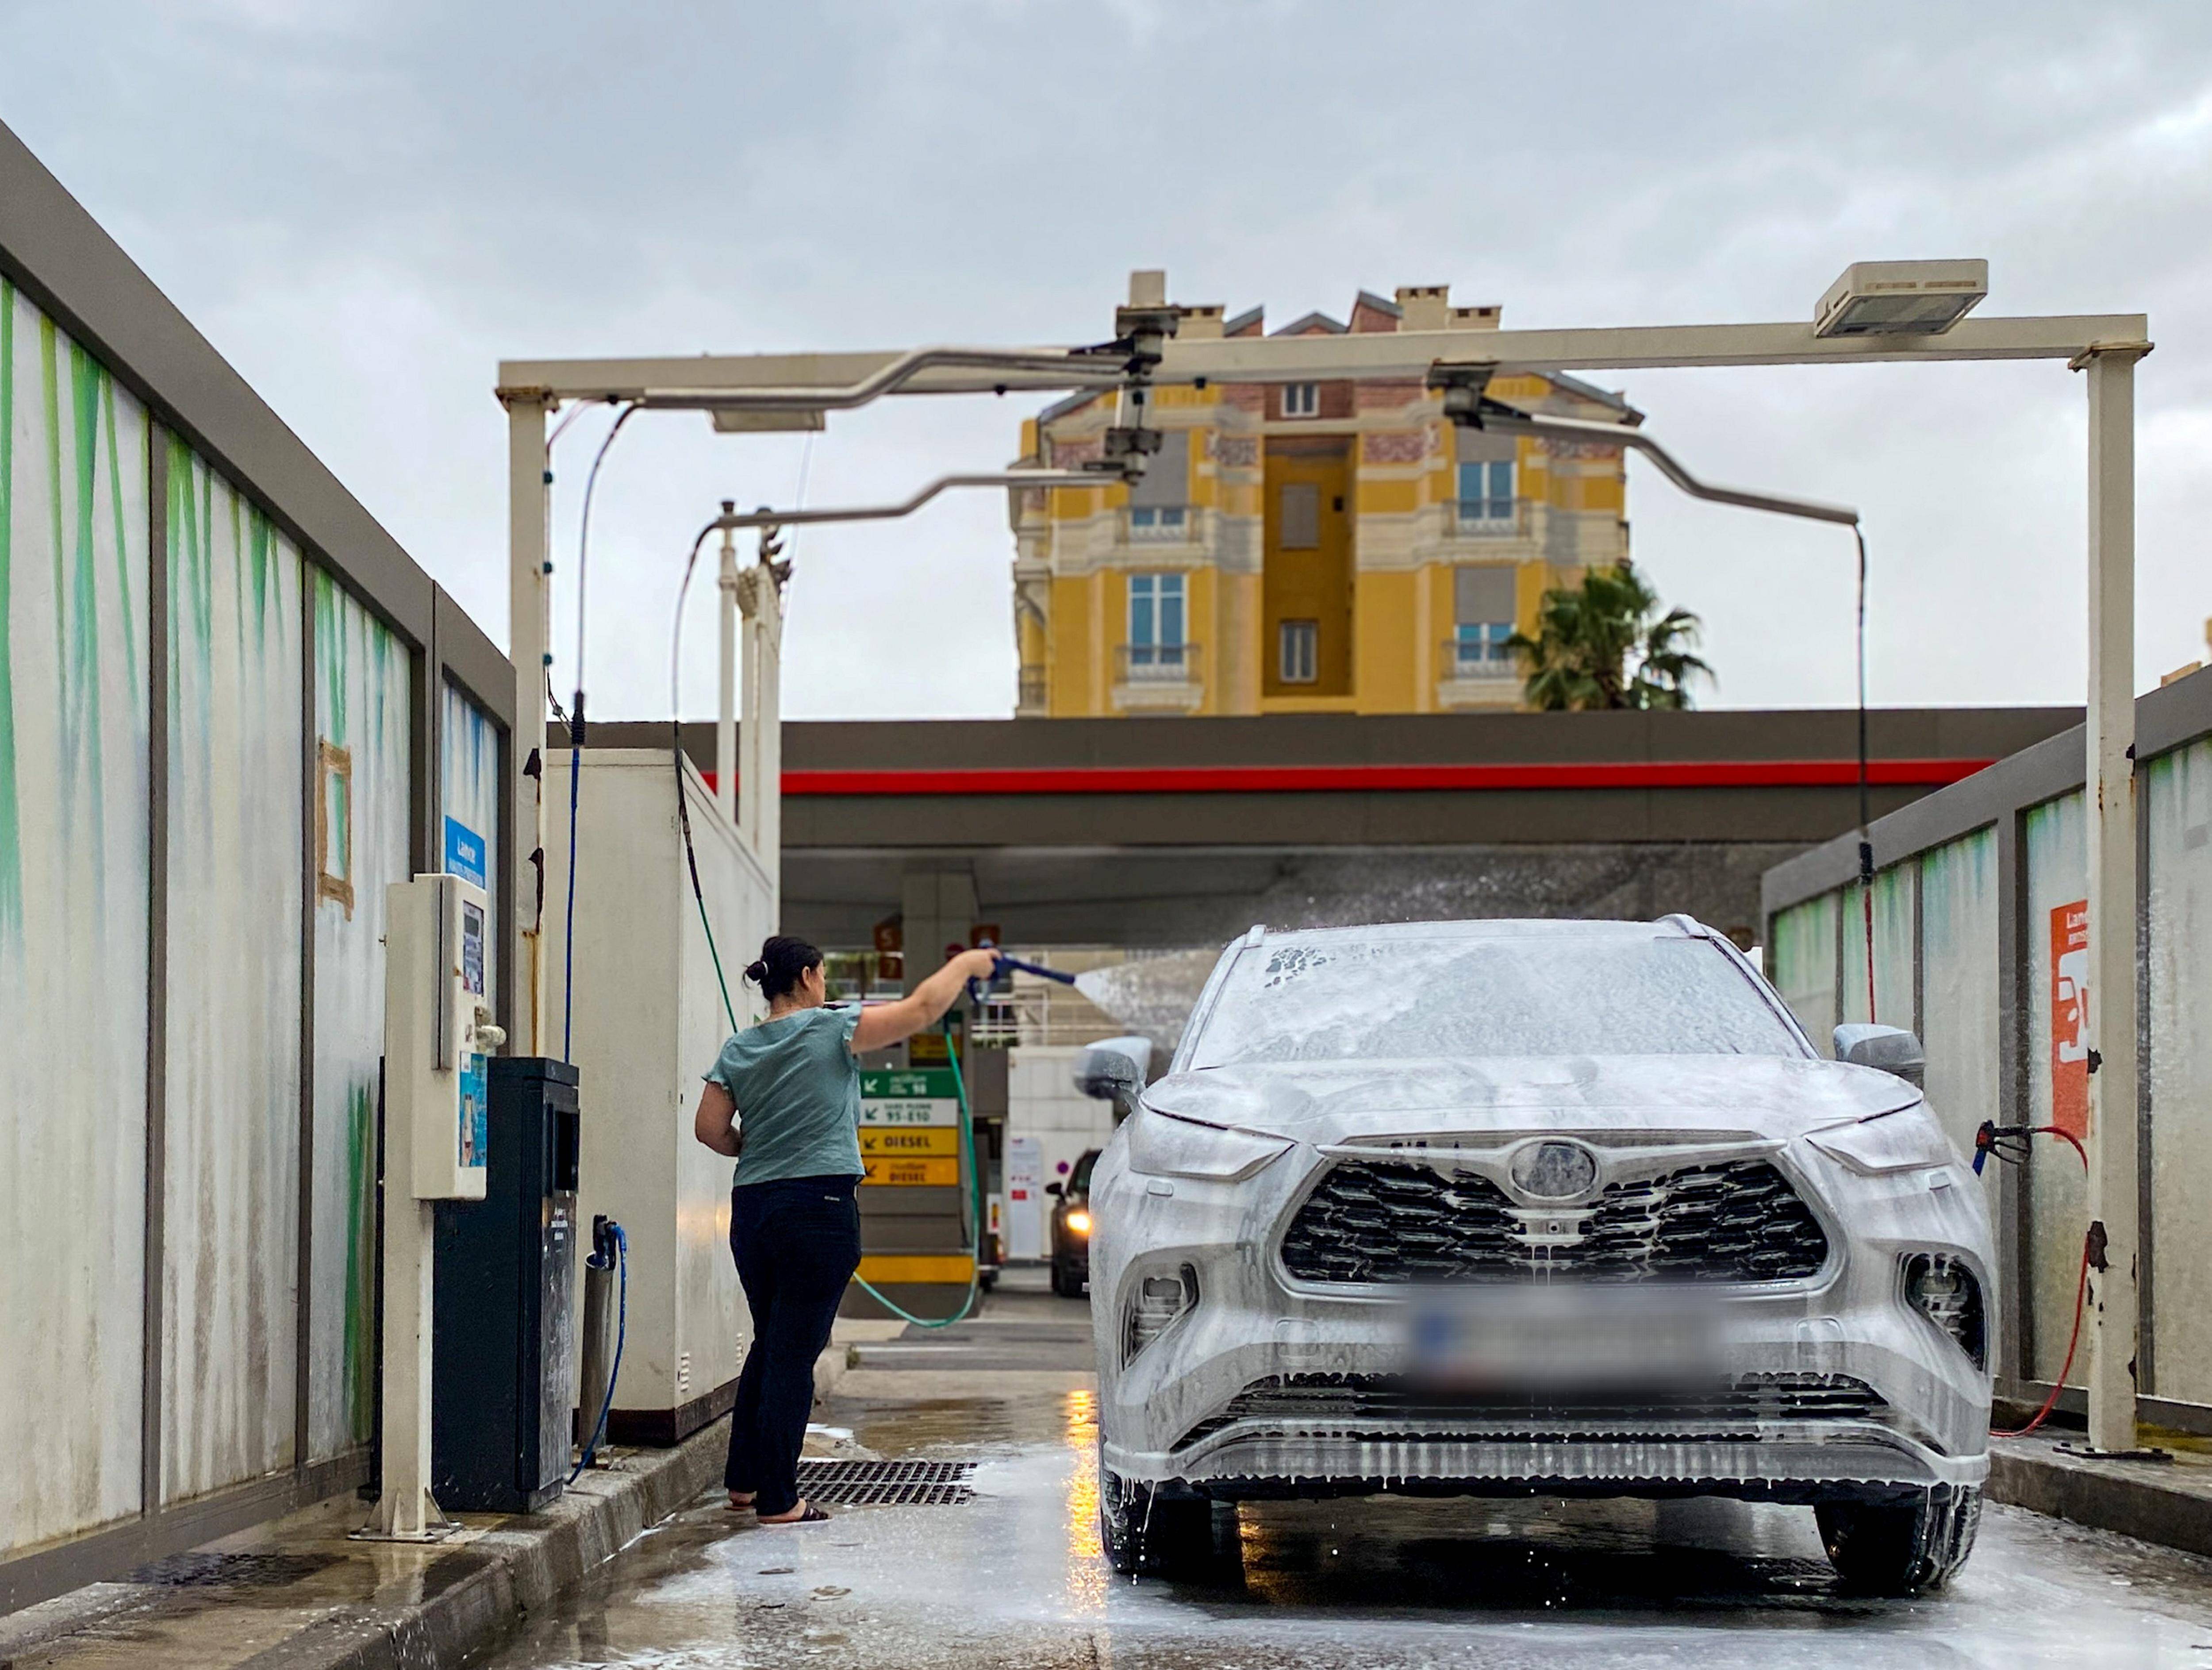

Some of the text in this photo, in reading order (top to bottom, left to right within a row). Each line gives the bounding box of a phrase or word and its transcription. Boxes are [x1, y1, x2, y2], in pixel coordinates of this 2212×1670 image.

[886, 1112, 931, 1122] 95-E10
[885, 1136, 931, 1148] DIESEL
[889, 1173, 926, 1182] DIESEL
